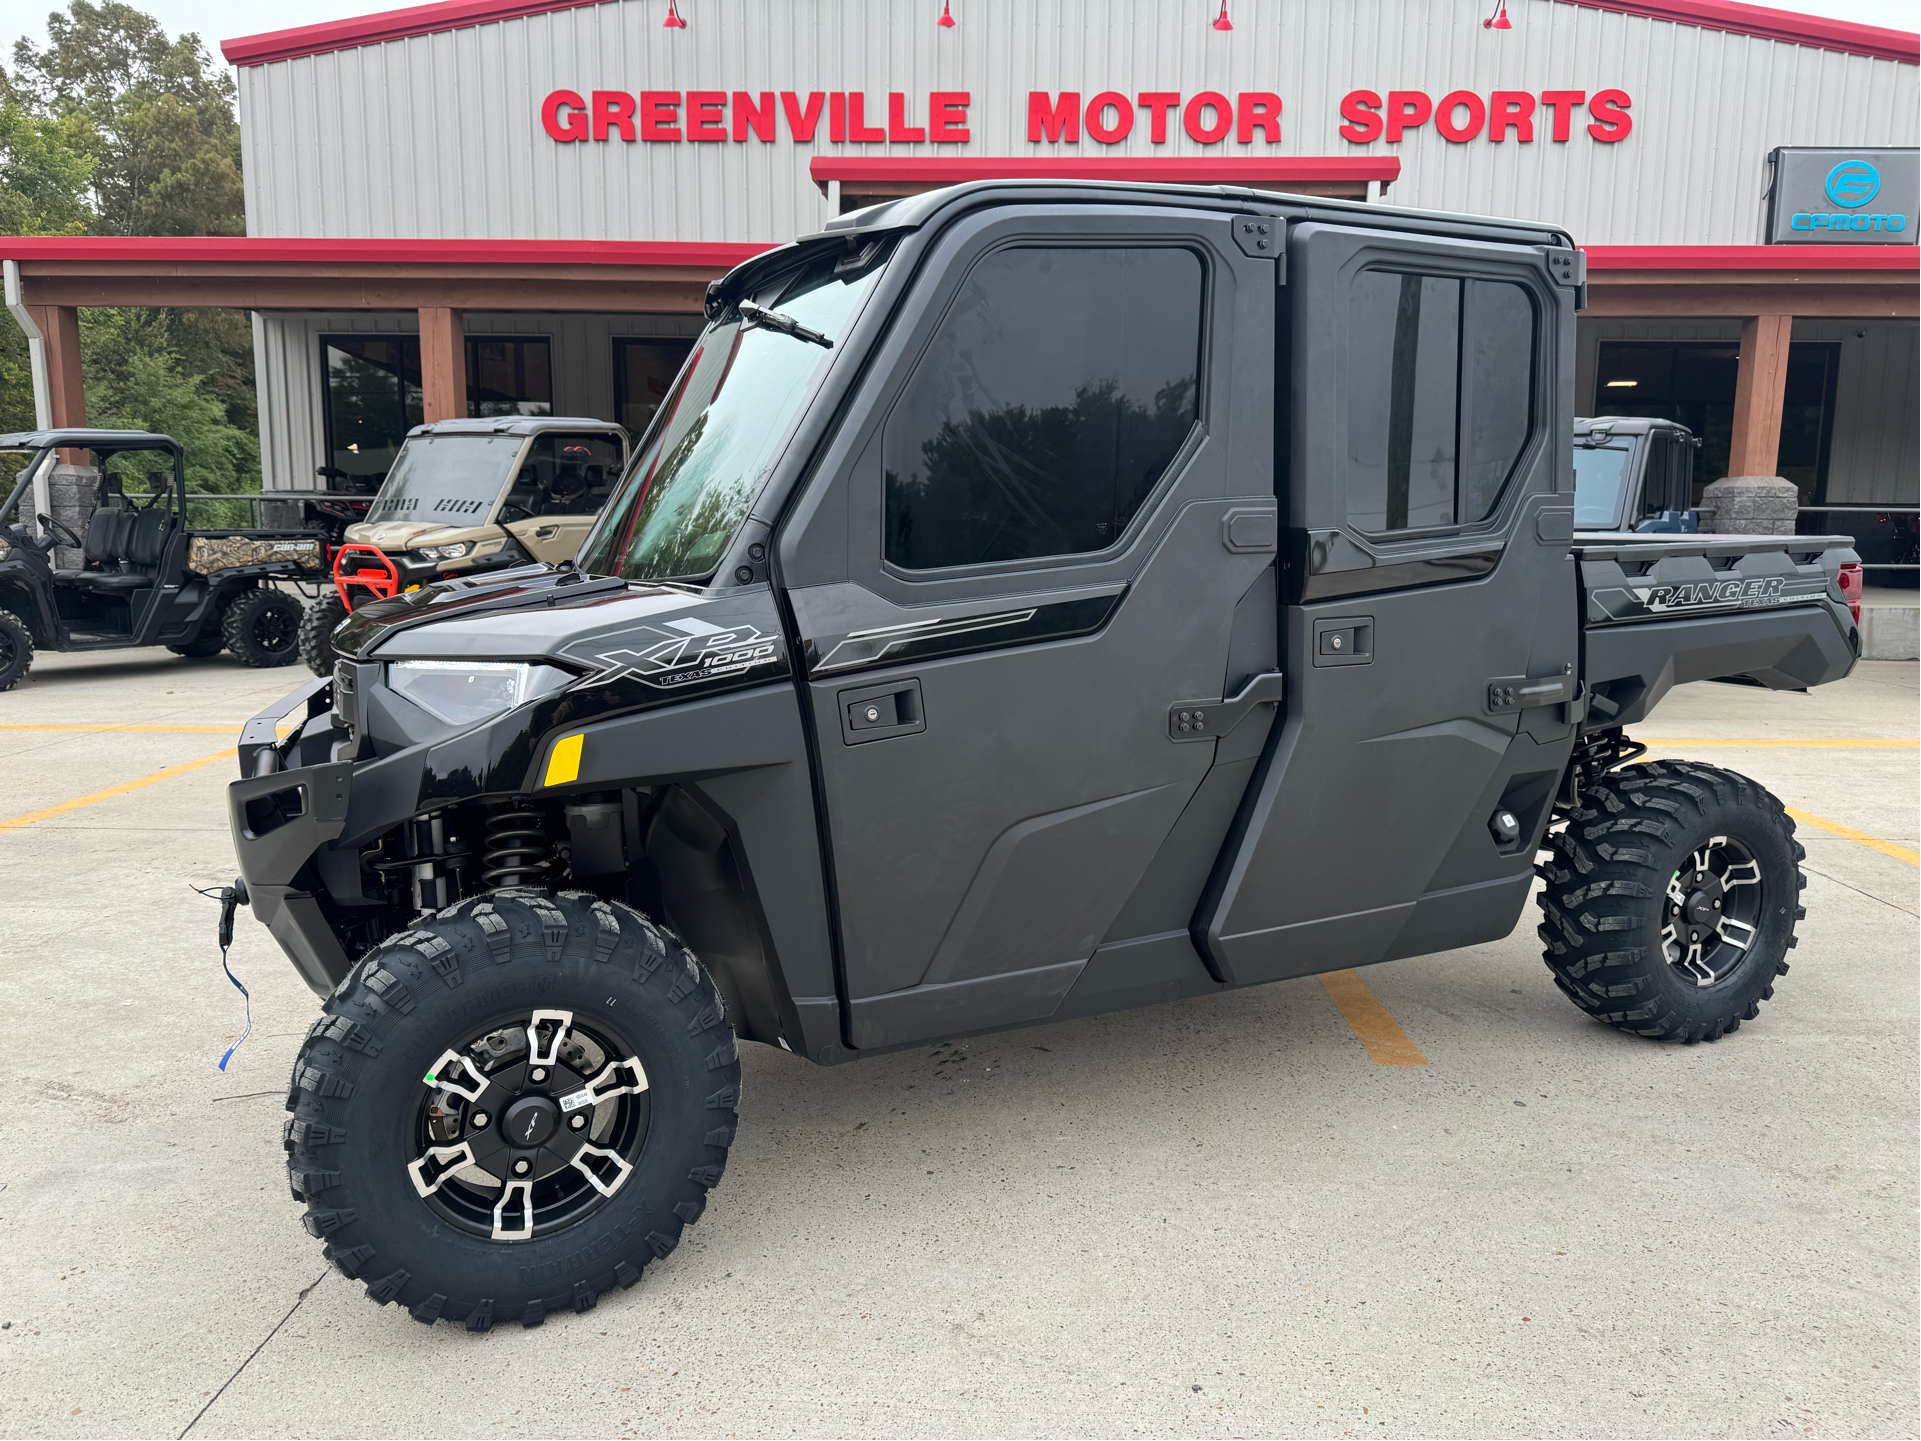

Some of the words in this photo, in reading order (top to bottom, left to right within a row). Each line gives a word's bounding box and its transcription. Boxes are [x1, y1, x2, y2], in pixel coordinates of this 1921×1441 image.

[541, 89, 970, 142] GREENVILLE
[1027, 90, 1282, 143] MOTOR
[1339, 88, 1632, 143] SPORTS
[1791, 213, 1906, 232] CFMOTO
[273, 543, 314, 551] can-am
[1644, 577, 1785, 607] RANGER
[1743, 596, 1780, 608] TEXAS
[703, 645, 775, 667] 1000
[659, 668, 712, 685] TEXAS
